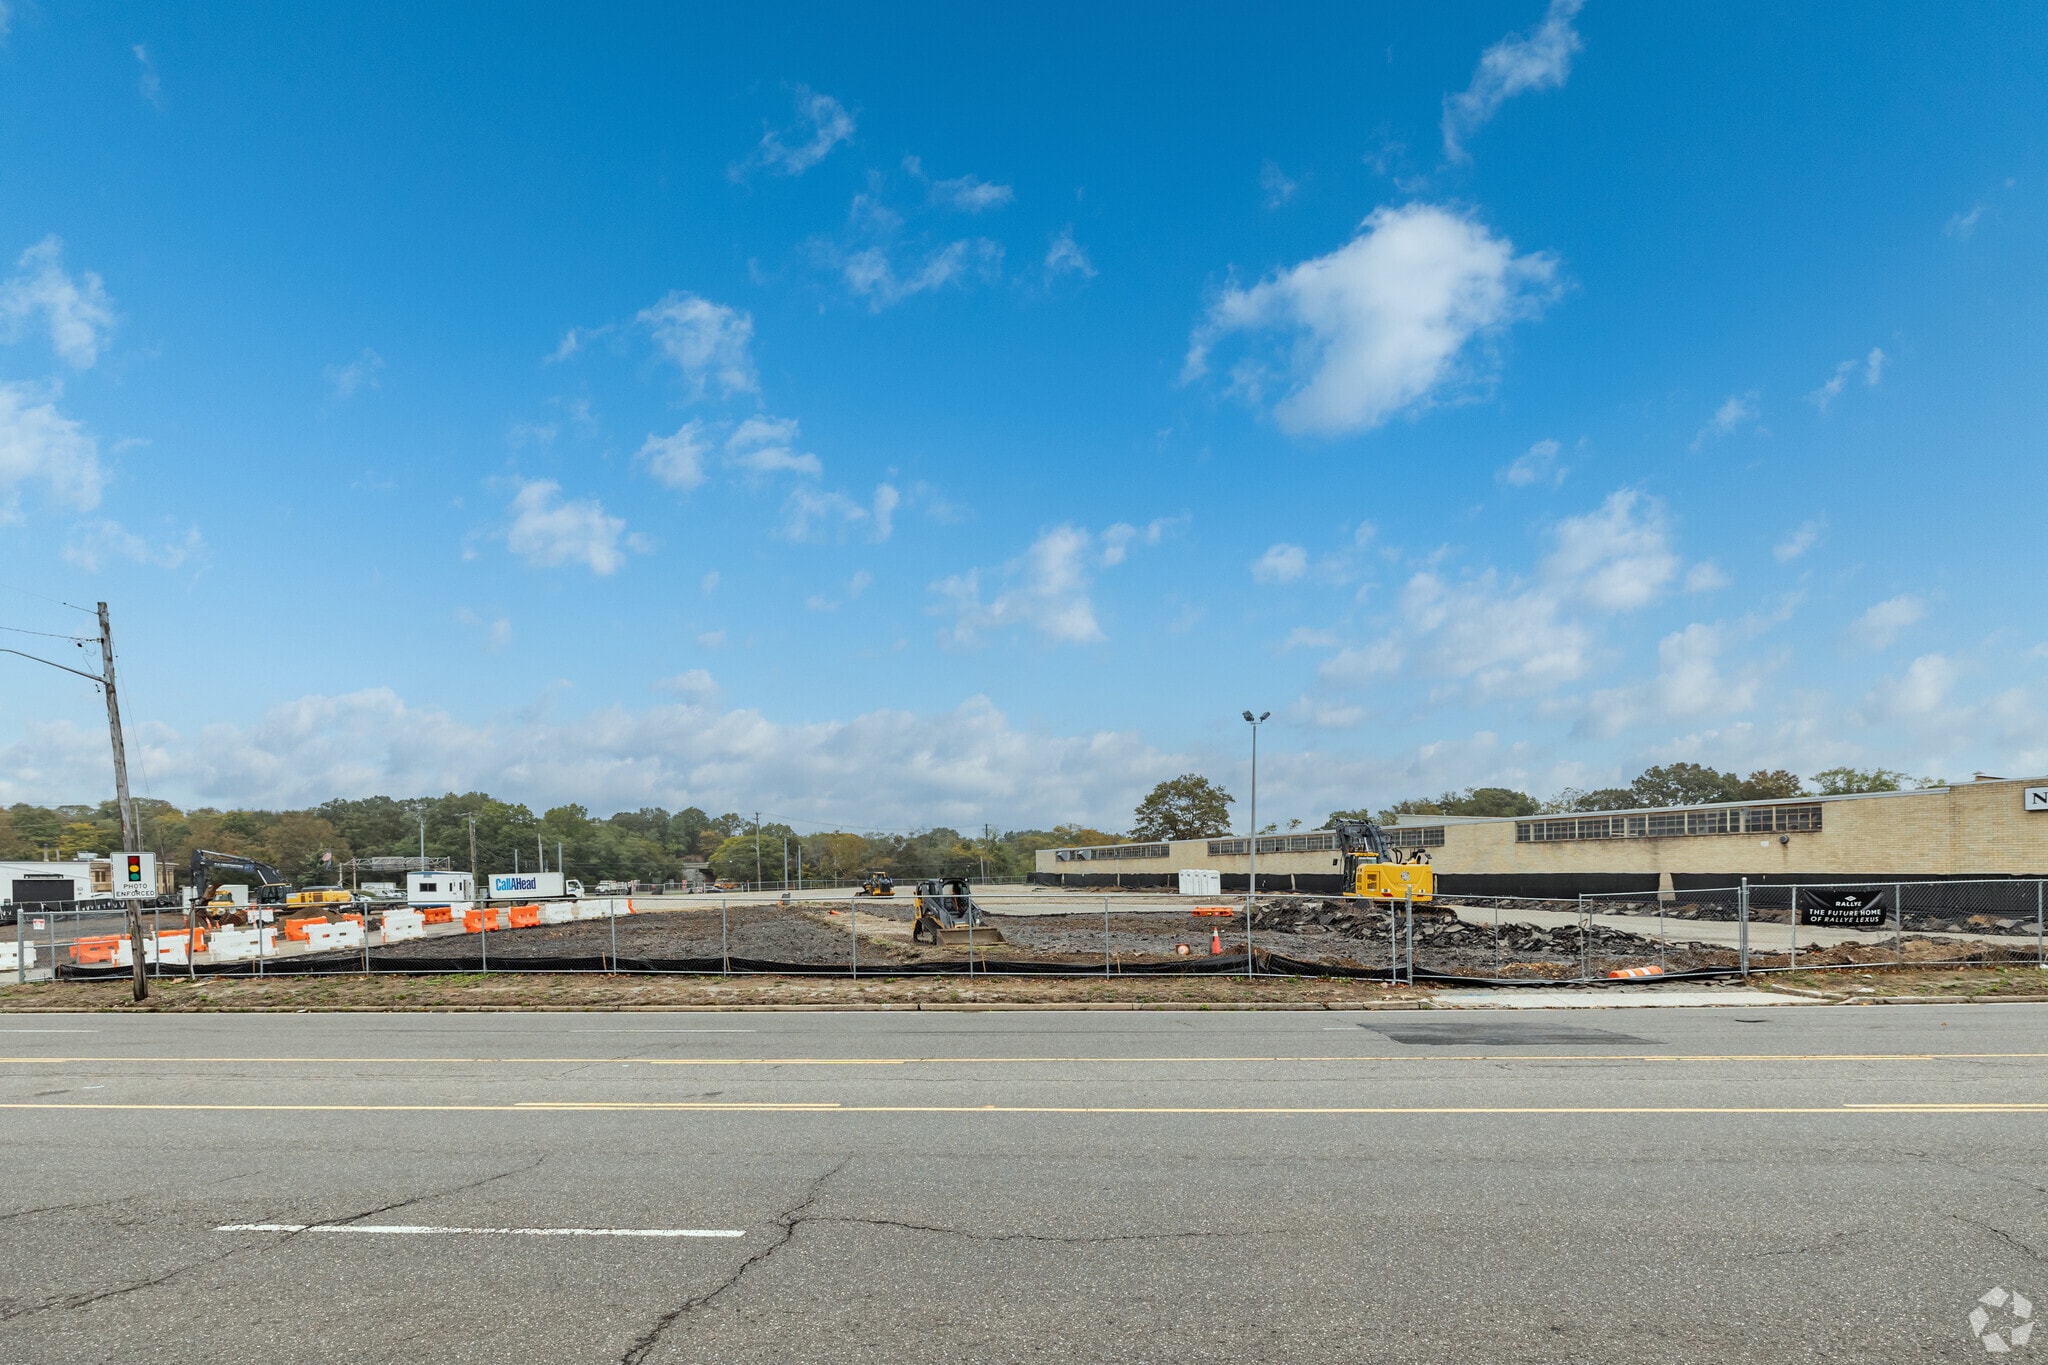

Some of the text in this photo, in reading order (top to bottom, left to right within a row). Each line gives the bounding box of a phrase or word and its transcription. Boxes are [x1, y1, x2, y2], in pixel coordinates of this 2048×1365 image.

[495, 877, 537, 891] CallAHead
[1809, 908, 1882, 917] THE FUTURE HOME
